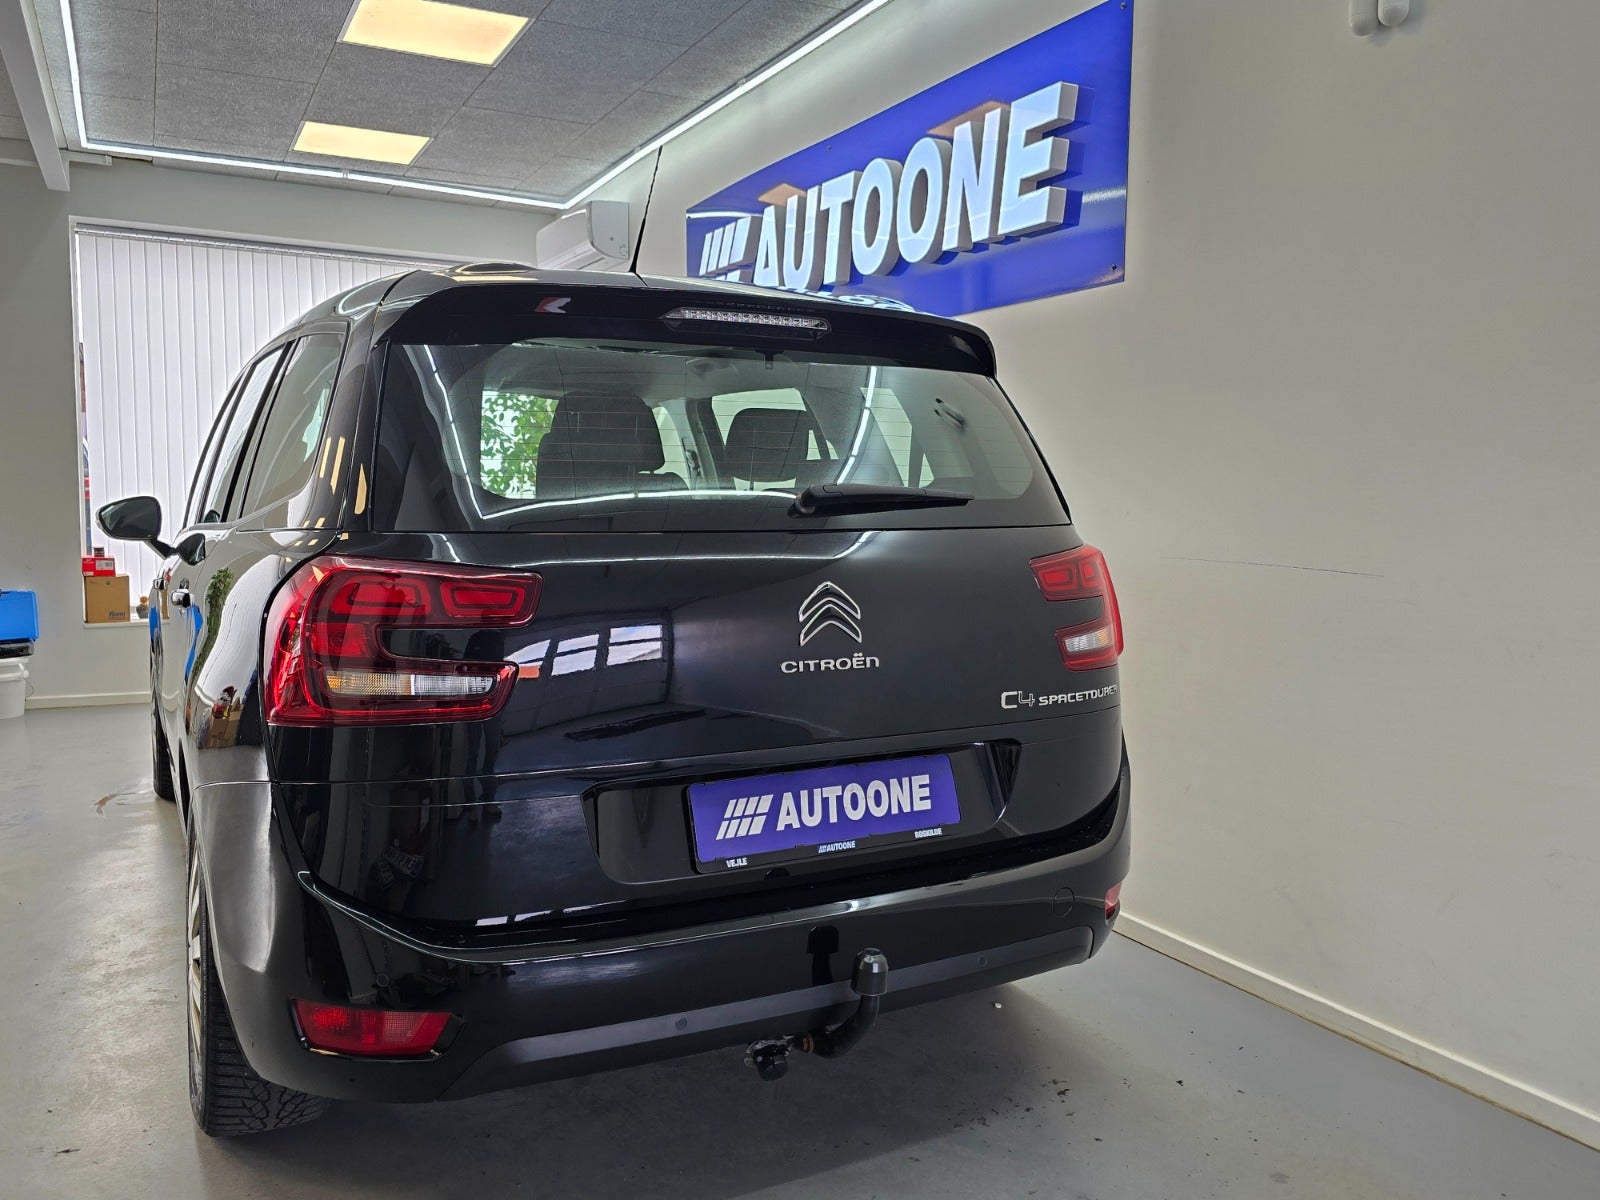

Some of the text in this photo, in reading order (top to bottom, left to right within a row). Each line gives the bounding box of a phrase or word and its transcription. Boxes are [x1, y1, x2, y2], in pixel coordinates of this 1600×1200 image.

[753, 81, 1078, 291] AUTOONE
[1000, 684, 1118, 709] C4 SPACETOURER
[776, 774, 931, 831] AUTOONE
[826, 840, 856, 853] AUTOONE
[726, 857, 748, 868] VEJLE
